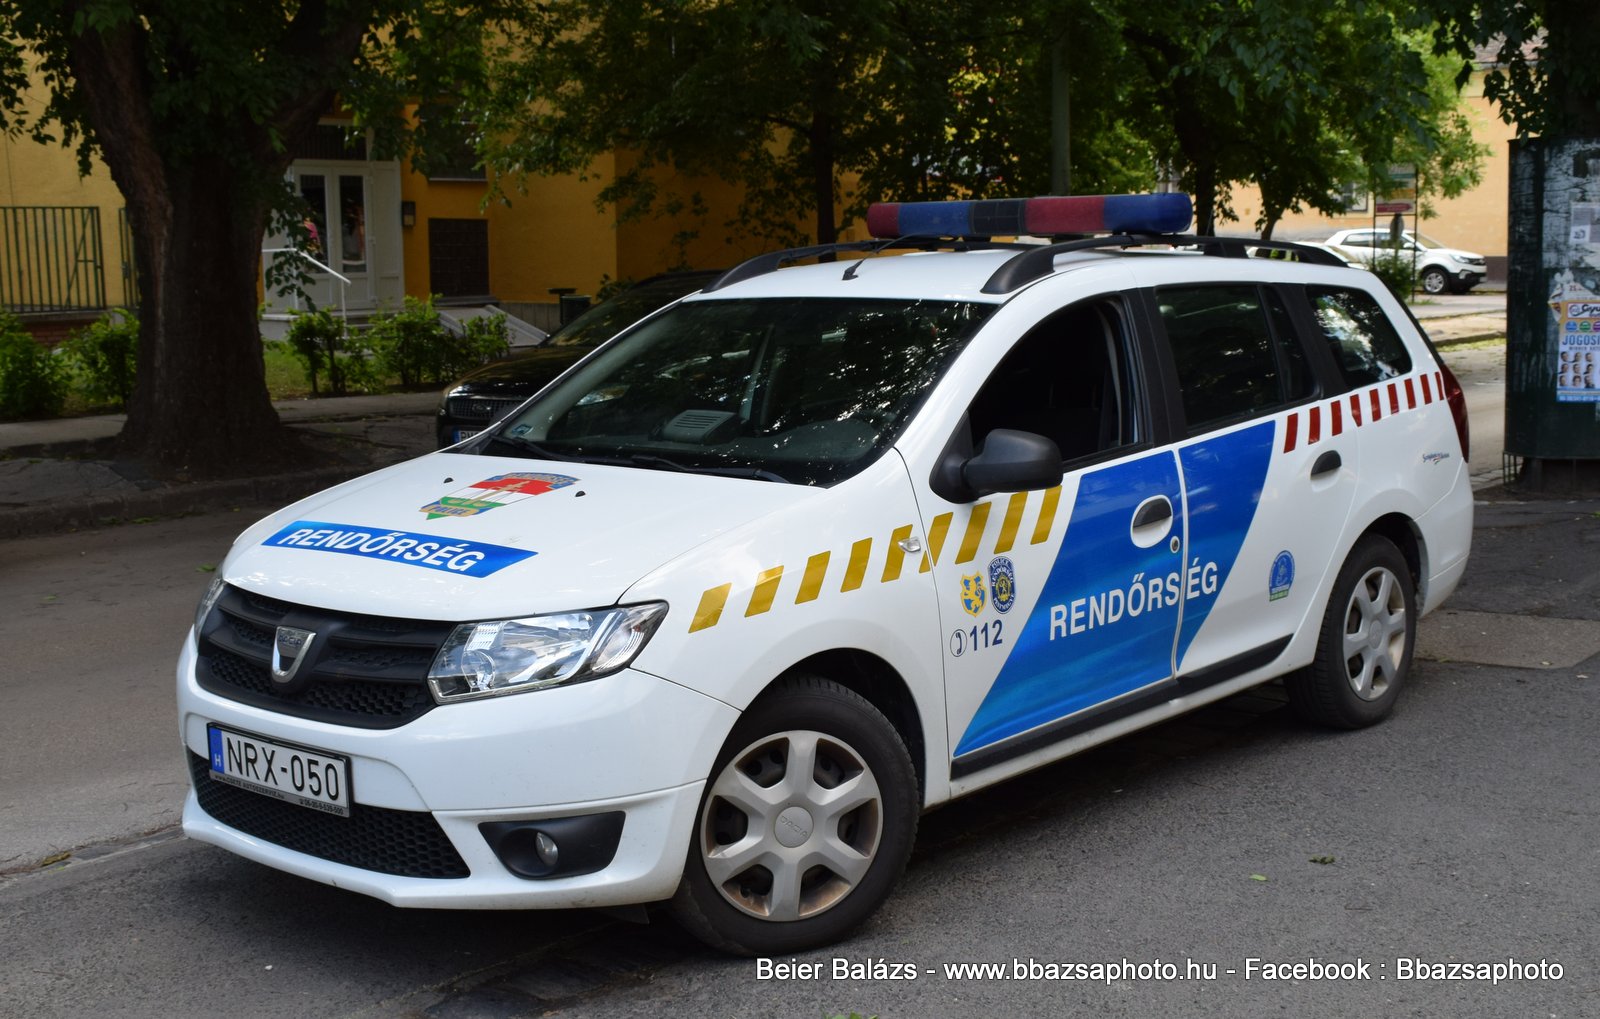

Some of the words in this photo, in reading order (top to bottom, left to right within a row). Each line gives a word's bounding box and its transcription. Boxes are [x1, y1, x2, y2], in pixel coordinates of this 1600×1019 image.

[277, 528, 485, 572] RENDŐRSÉG
[1050, 557, 1218, 641] RENDŐRSÉG
[969, 619, 1003, 651] 112
[214, 753, 222, 767] H
[227, 737, 339, 801] NRX-050
